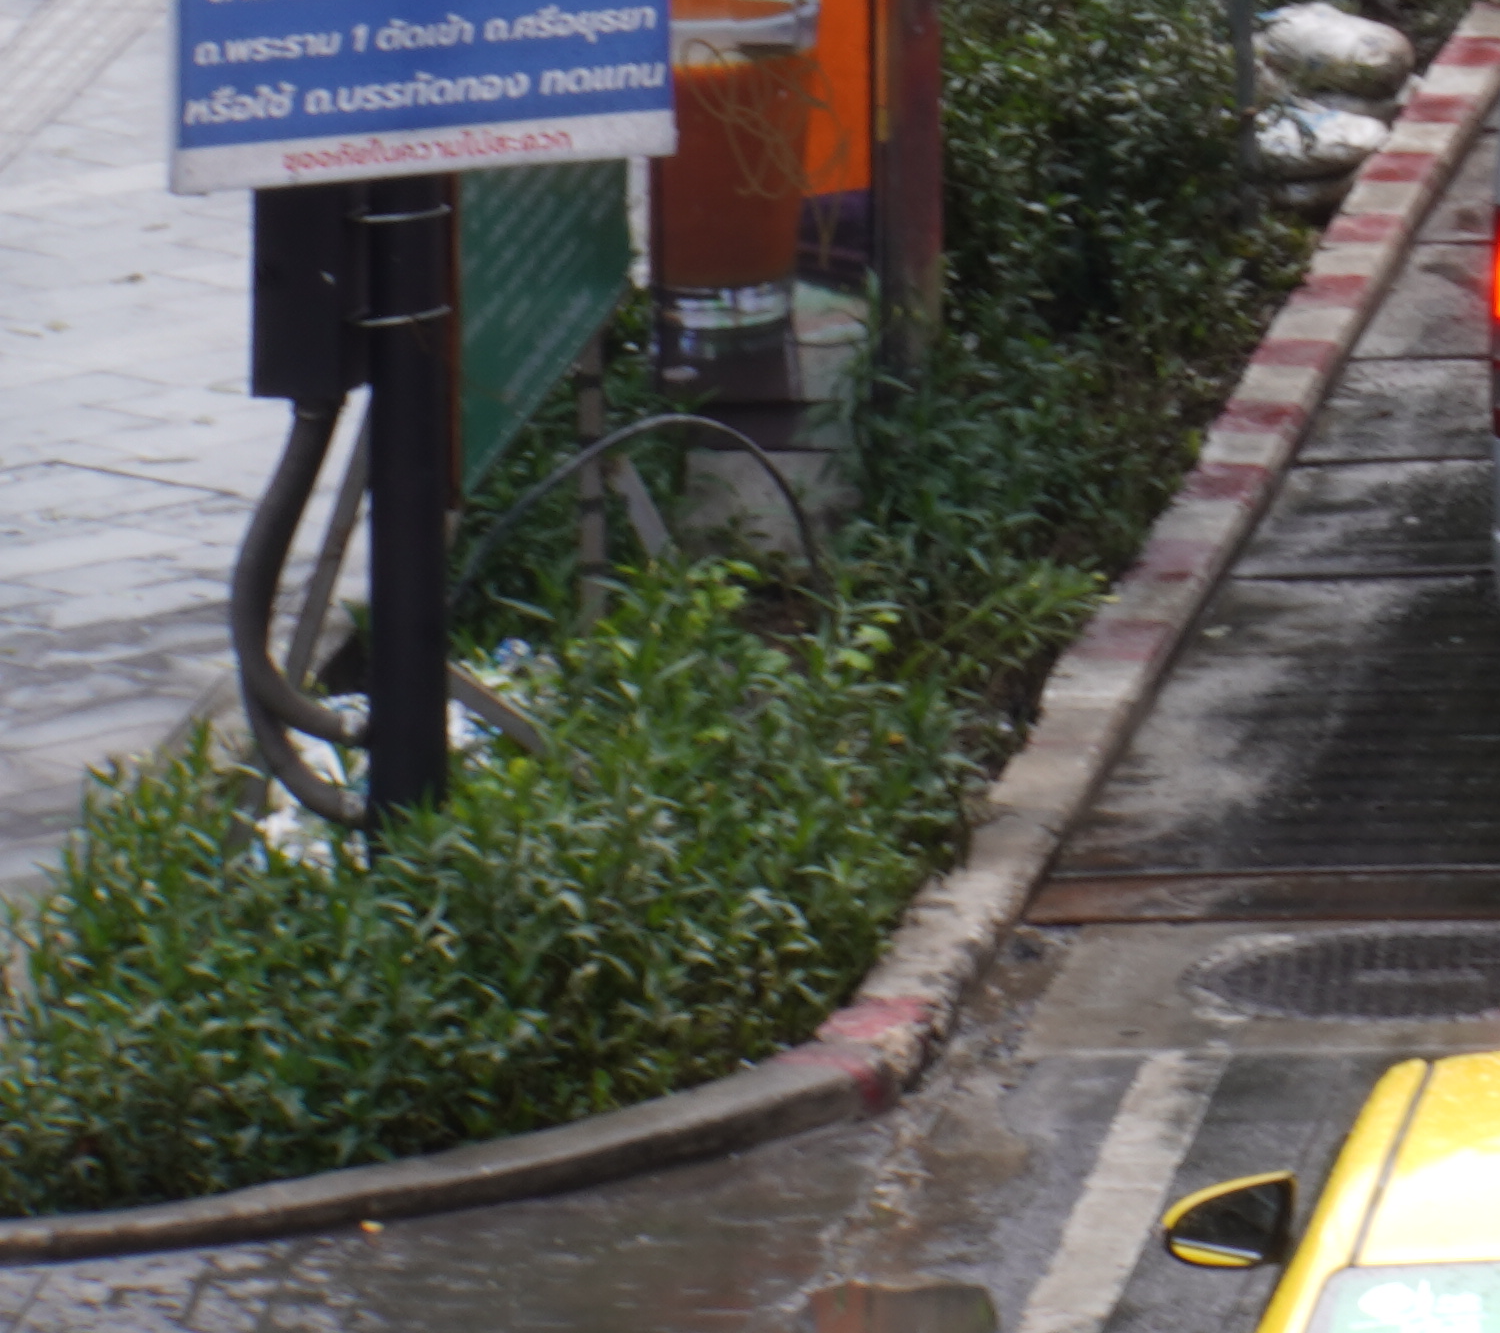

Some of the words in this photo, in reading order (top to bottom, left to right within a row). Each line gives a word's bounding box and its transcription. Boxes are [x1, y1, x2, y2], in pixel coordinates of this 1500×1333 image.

[193, 29, 342, 66] ถ.พระราม
[352, 24, 369, 53] 1
[183, 82, 297, 126] หรือใช้
[304, 71, 530, 115] ถ.บรรทัดทอง
[539, 62, 666, 96] ทดแทน
